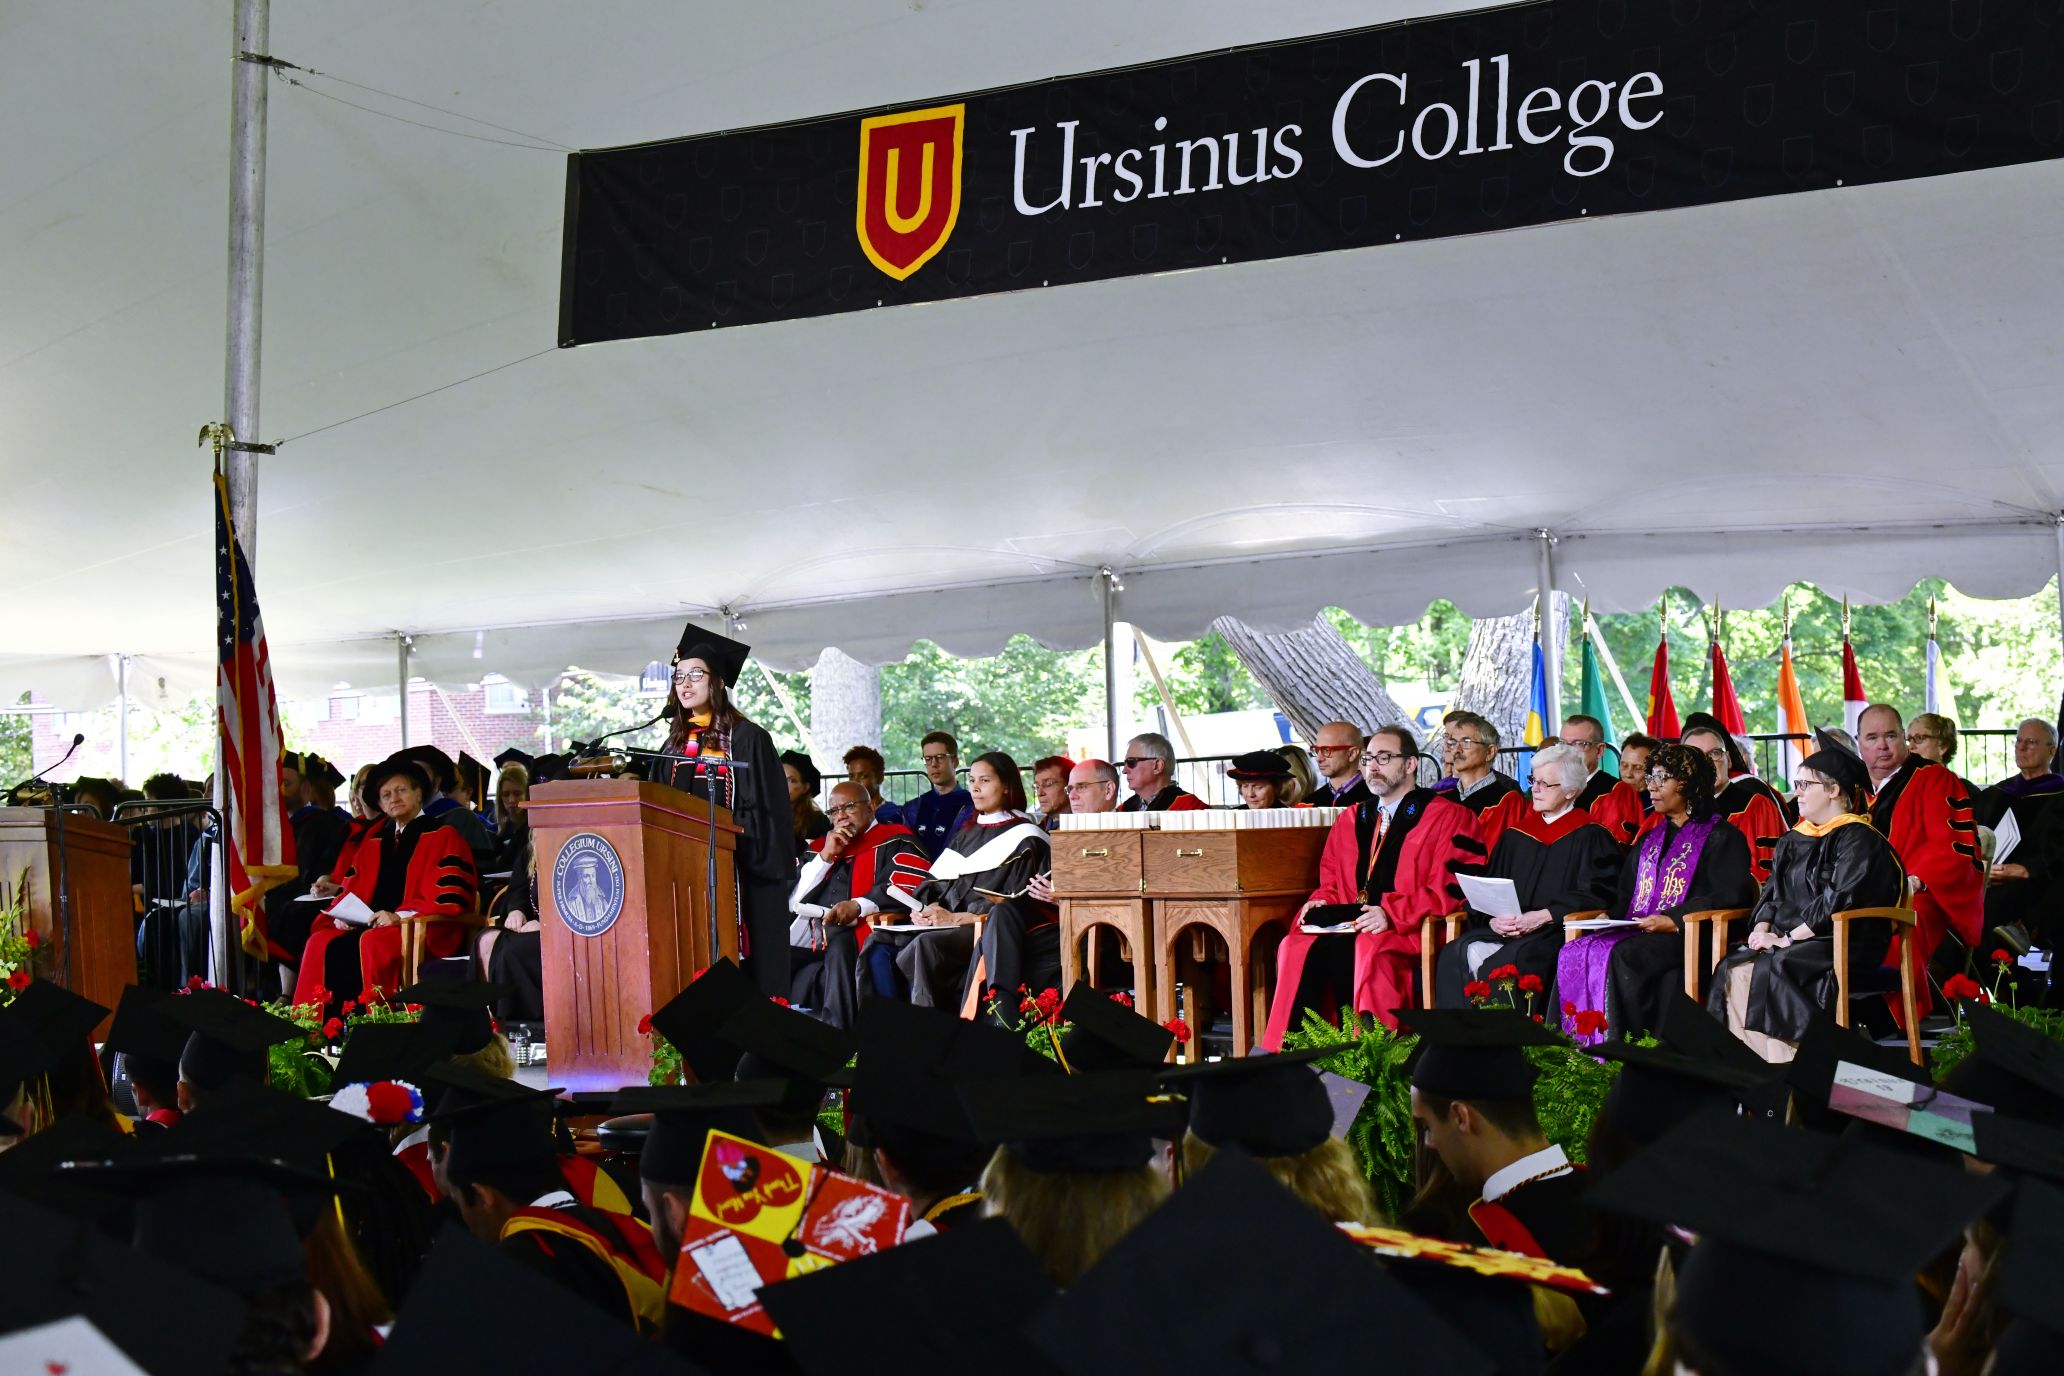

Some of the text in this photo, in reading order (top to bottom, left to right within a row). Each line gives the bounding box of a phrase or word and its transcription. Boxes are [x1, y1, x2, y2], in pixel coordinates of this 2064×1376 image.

[1010, 53, 1664, 216] Ursinus College
[886, 143, 934, 234] U
[557, 838, 619, 877] COLLEGIUM URSINI
